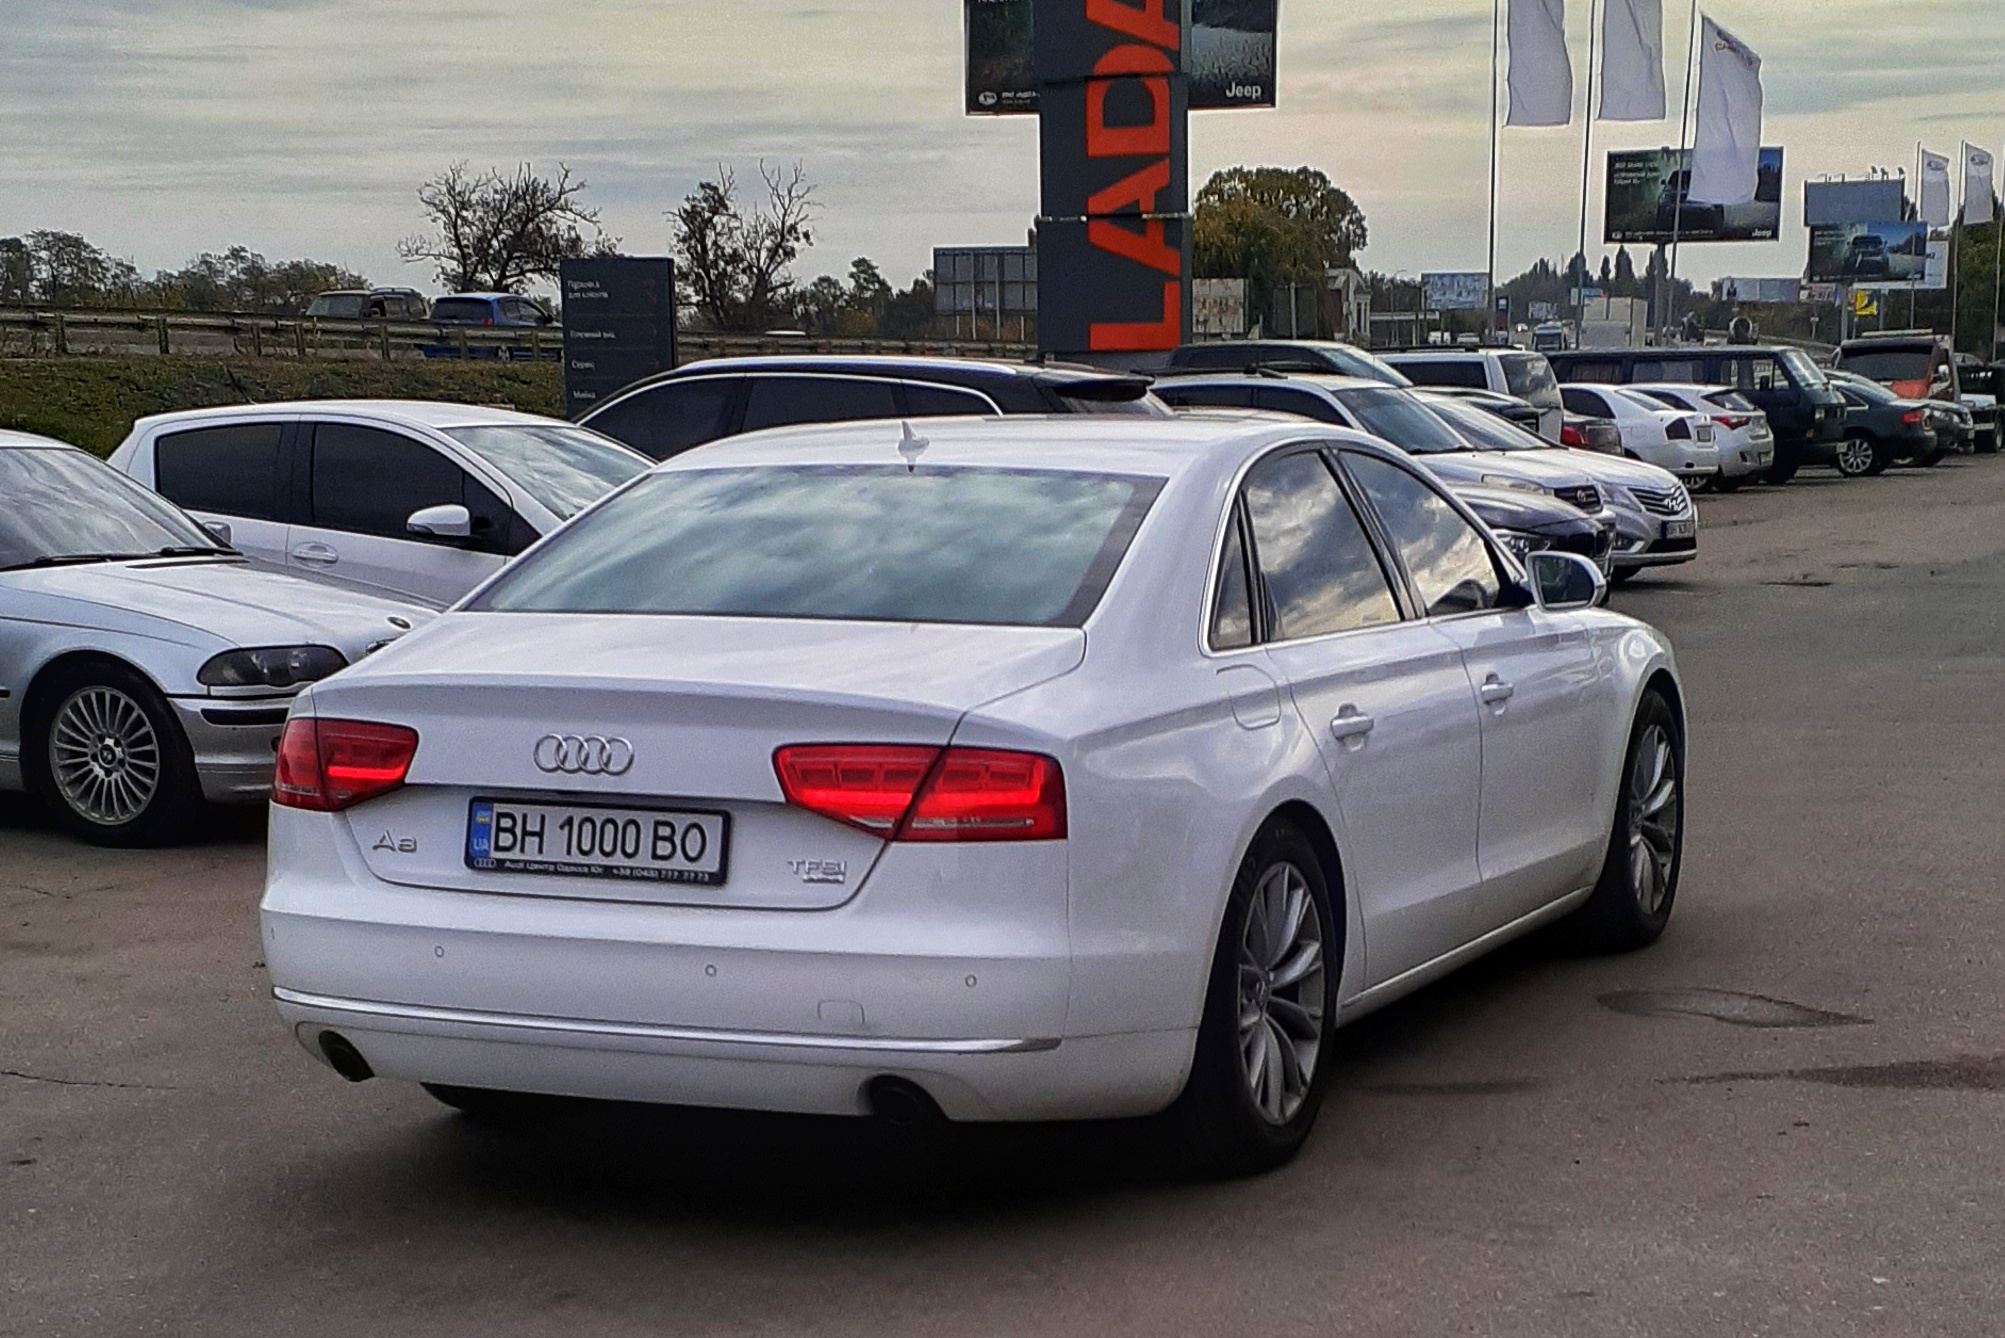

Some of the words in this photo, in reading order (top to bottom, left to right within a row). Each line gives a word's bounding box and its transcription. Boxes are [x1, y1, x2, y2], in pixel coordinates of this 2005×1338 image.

[1225, 81, 1262, 99] Jeep
[473, 838, 489, 851] UA
[493, 811, 546, 854] BH
[558, 815, 642, 860] 1000
[650, 819, 708, 863] BO
